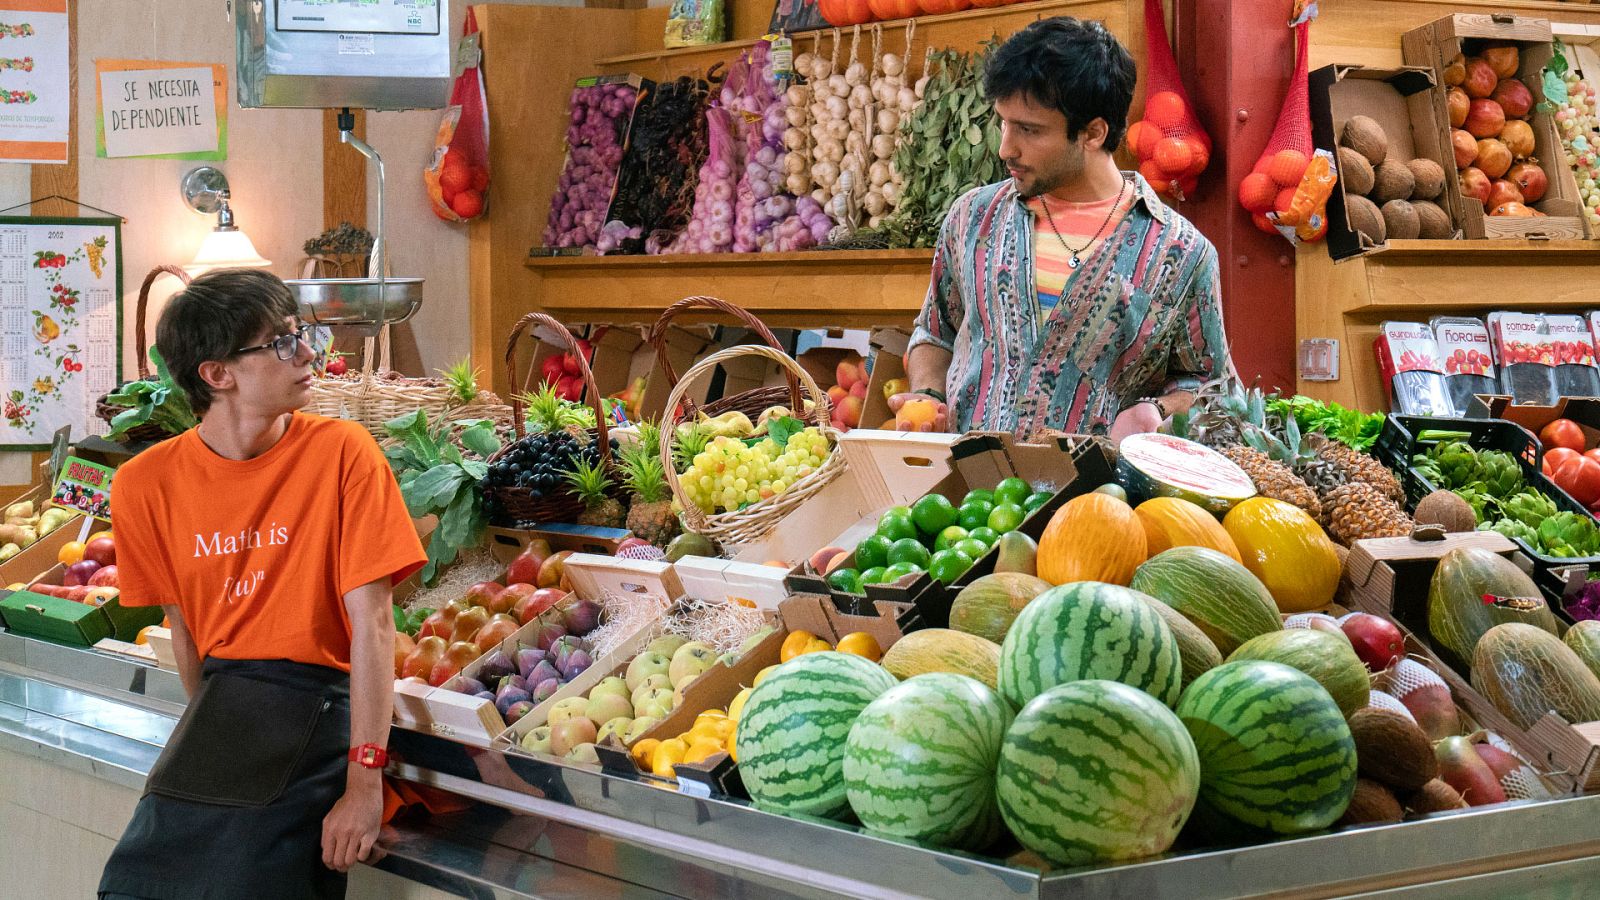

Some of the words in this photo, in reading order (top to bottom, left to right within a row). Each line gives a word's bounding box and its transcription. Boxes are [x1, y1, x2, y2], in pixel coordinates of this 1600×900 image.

[124, 81, 139, 102] SE
[148, 80, 201, 100] NECESITA
[112, 105, 202, 131] DEPENDIENTE
[48, 231, 64, 239] 2002
[1506, 323, 1536, 332] tomate
[1550, 324, 1576, 332] miento
[67, 462, 105, 486] FRUTAS
[193, 526, 262, 558] Math
[268, 522, 289, 545] is
